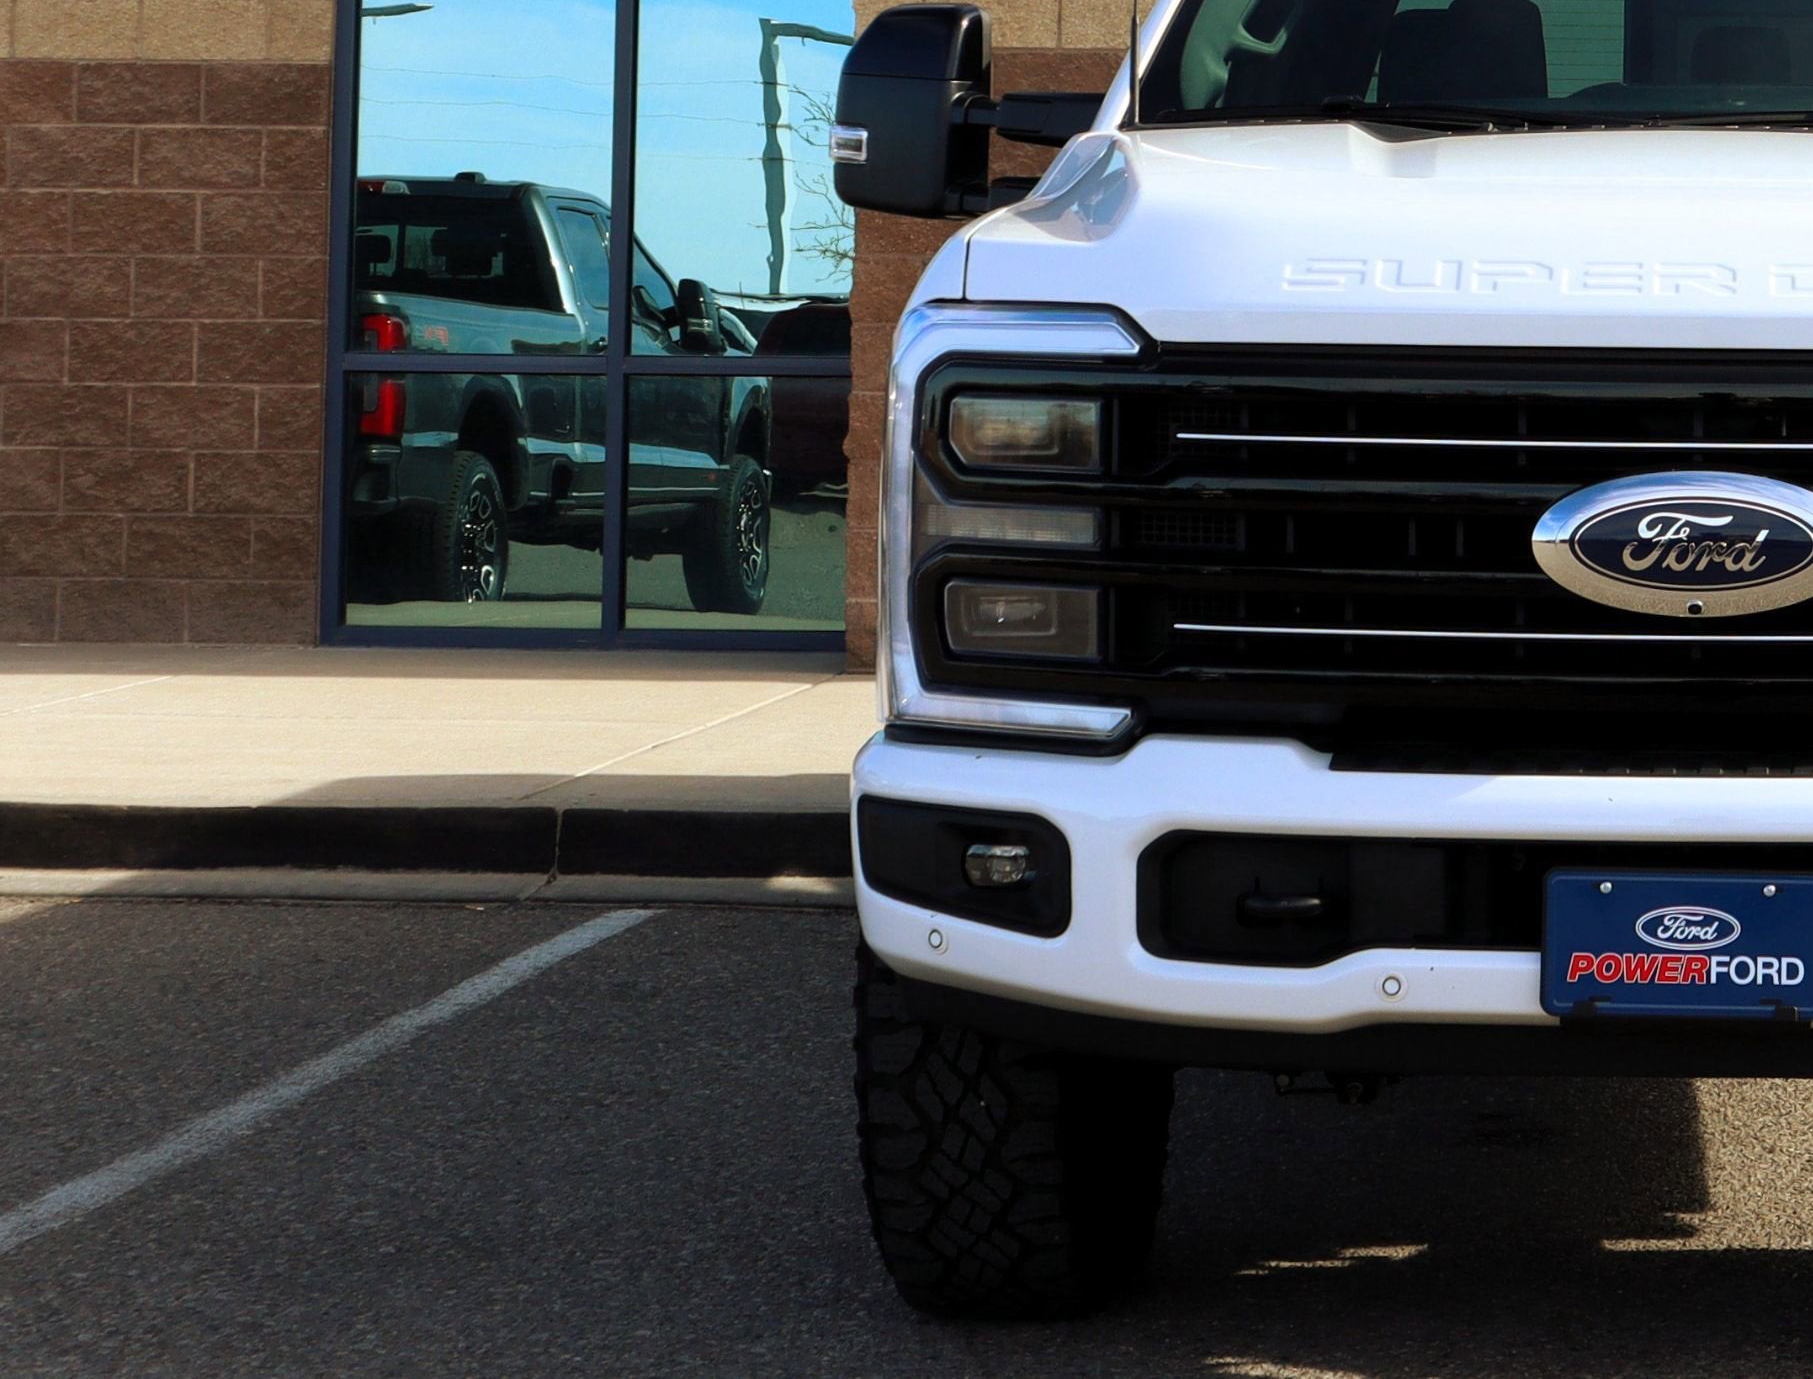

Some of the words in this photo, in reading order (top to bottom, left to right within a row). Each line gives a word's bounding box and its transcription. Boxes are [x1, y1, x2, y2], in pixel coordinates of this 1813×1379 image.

[1281, 257, 1739, 297] SUPER
[1621, 512, 1770, 572] Ford
[1656, 913, 1719, 941] Ford
